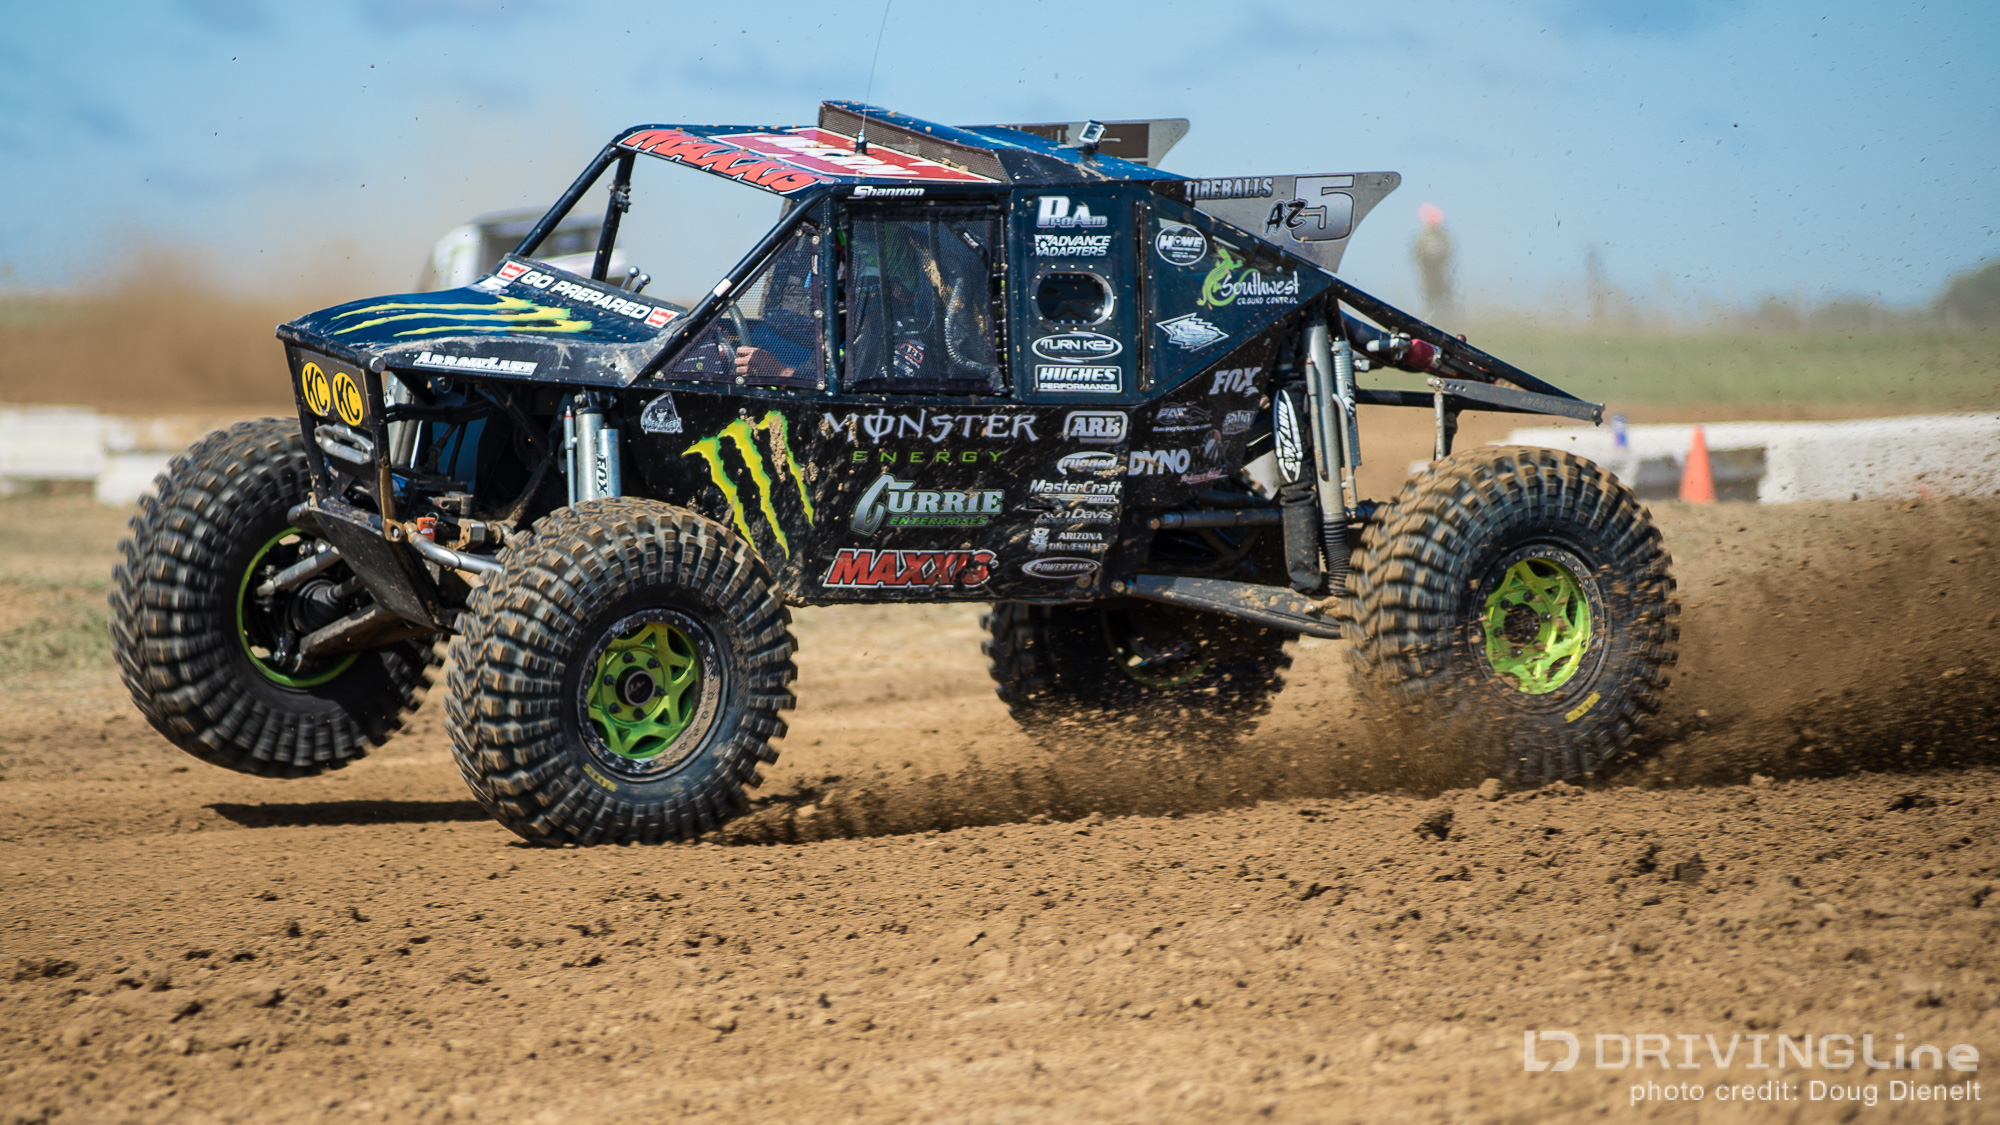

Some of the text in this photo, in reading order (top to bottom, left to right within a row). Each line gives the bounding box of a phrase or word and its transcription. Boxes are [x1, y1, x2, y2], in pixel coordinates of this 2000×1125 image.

[853, 186, 925, 198] Shannon
[1184, 177, 1273, 200] TIREBALLS
[1291, 174, 1355, 242] 5
[1048, 235, 1111, 246] ADVANCE
[1159, 235, 1202, 250] HOWE
[1042, 246, 1107, 257] ADAPTERS
[1220, 271, 1299, 298] Southwest
[520, 270, 555, 289] GO
[550, 280, 651, 320] PREPARED
[1039, 367, 1117, 382] HUGHES
[1208, 366, 1261, 396] FOX
[305, 366, 328, 415] KC
[1040, 382, 1117, 390] PERFORMANCE
[335, 376, 360, 422] KC
[1070, 416, 1121, 437] ARB
[852, 450, 1004, 463] ENERGY
[1029, 479, 1122, 494] MasterCraft
[889, 516, 988, 526] ENTERPRISES
[1071, 508, 1114, 519] Davis
[1058, 532, 1103, 540] ARIZONA
[823, 549, 998, 588] MAXXIS
